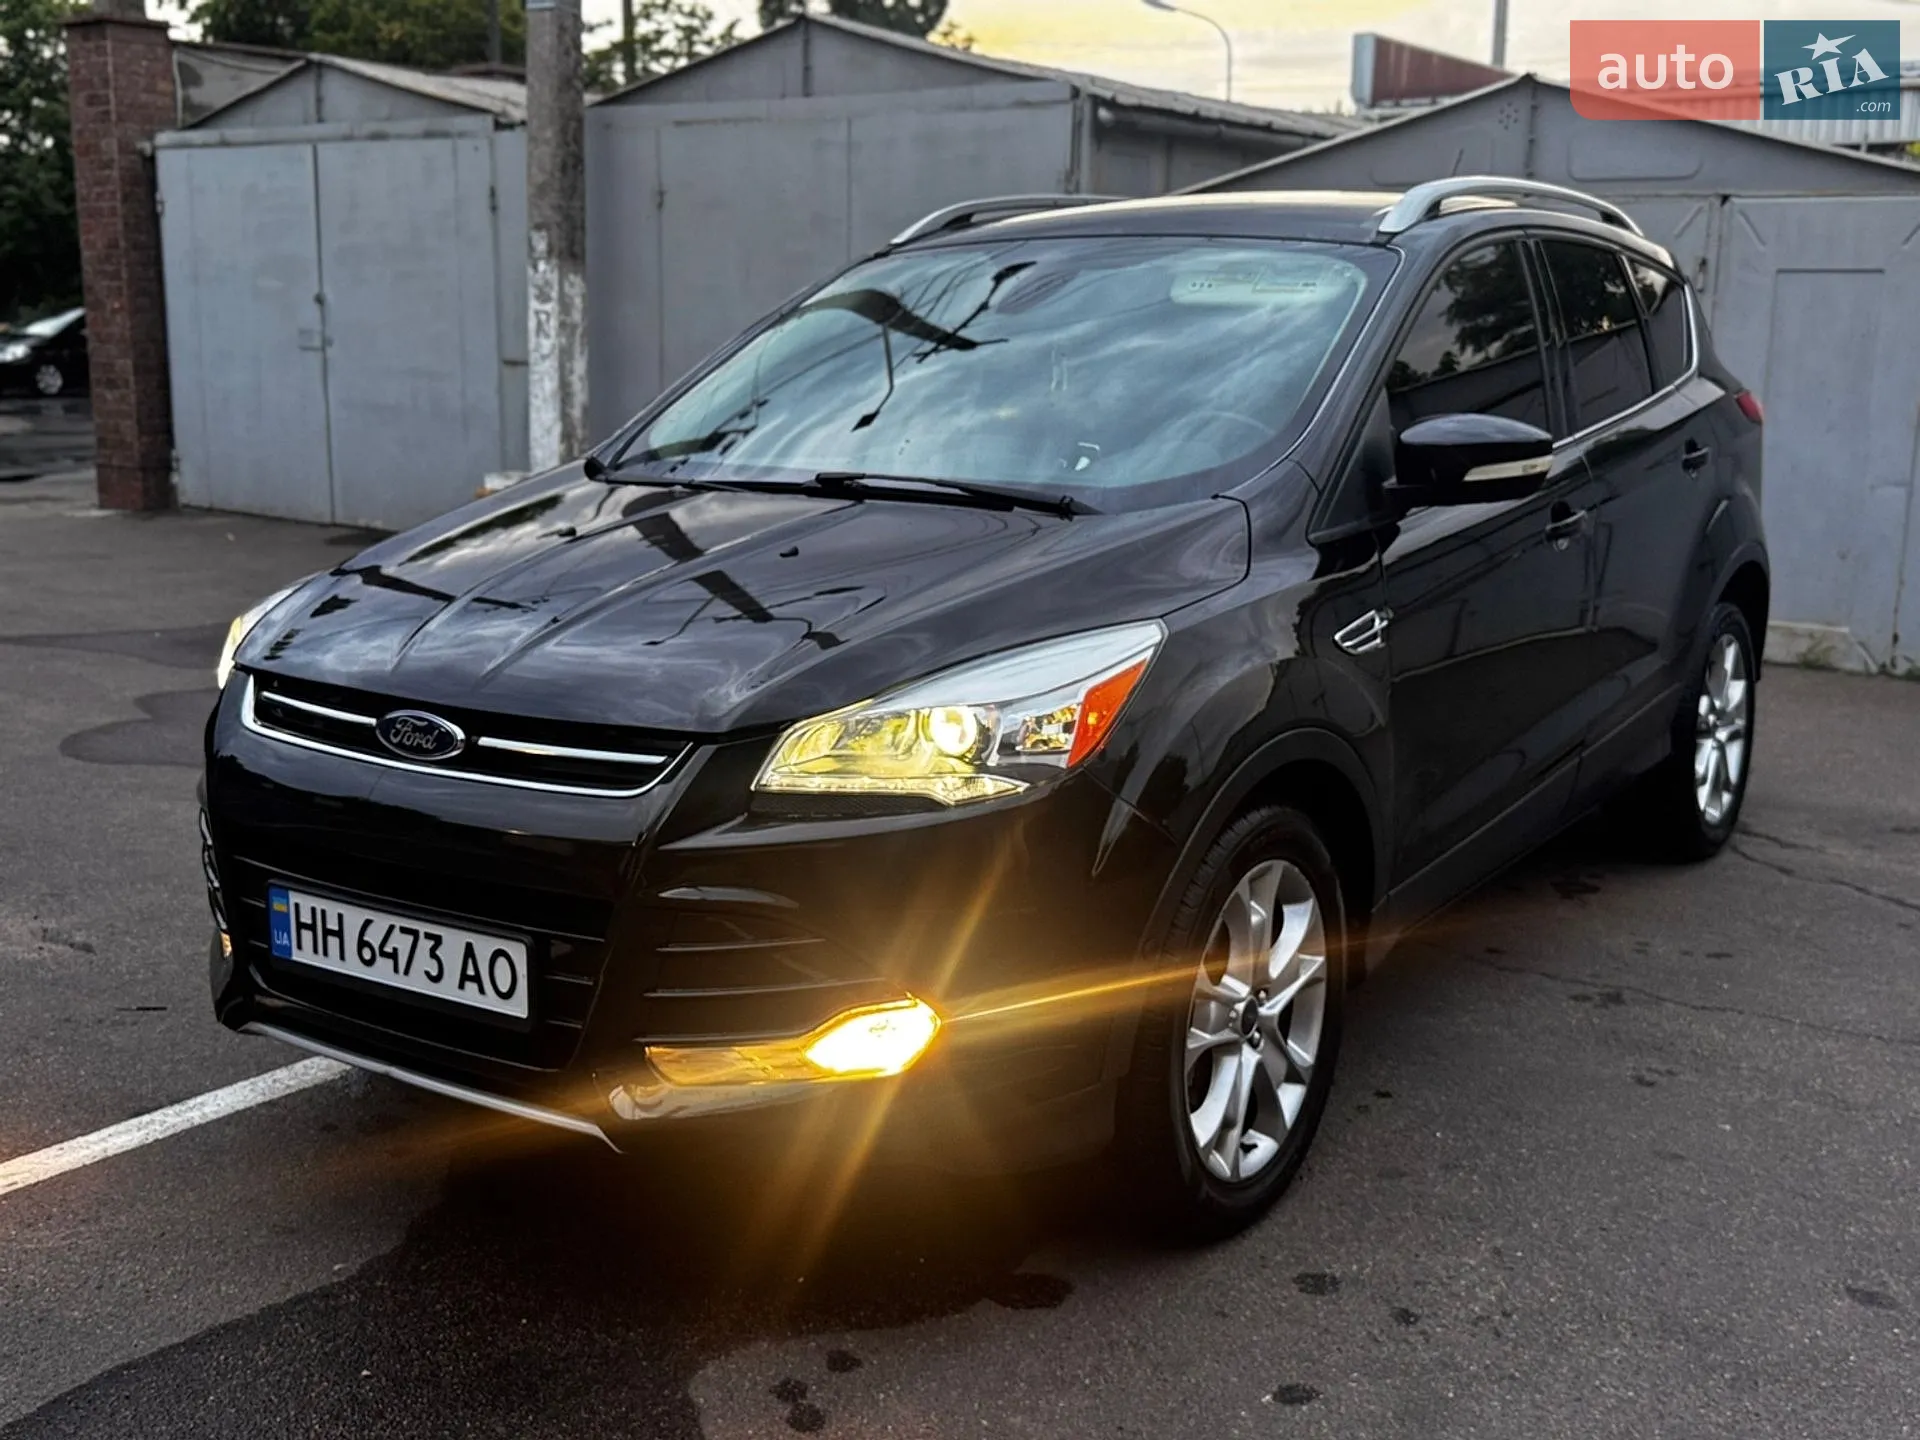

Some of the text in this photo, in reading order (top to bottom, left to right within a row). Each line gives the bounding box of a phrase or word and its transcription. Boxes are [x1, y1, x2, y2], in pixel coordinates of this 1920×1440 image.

[390, 716, 439, 749] Ford
[273, 930, 289, 945] UA
[294, 902, 517, 1000] HH 6473 AO
